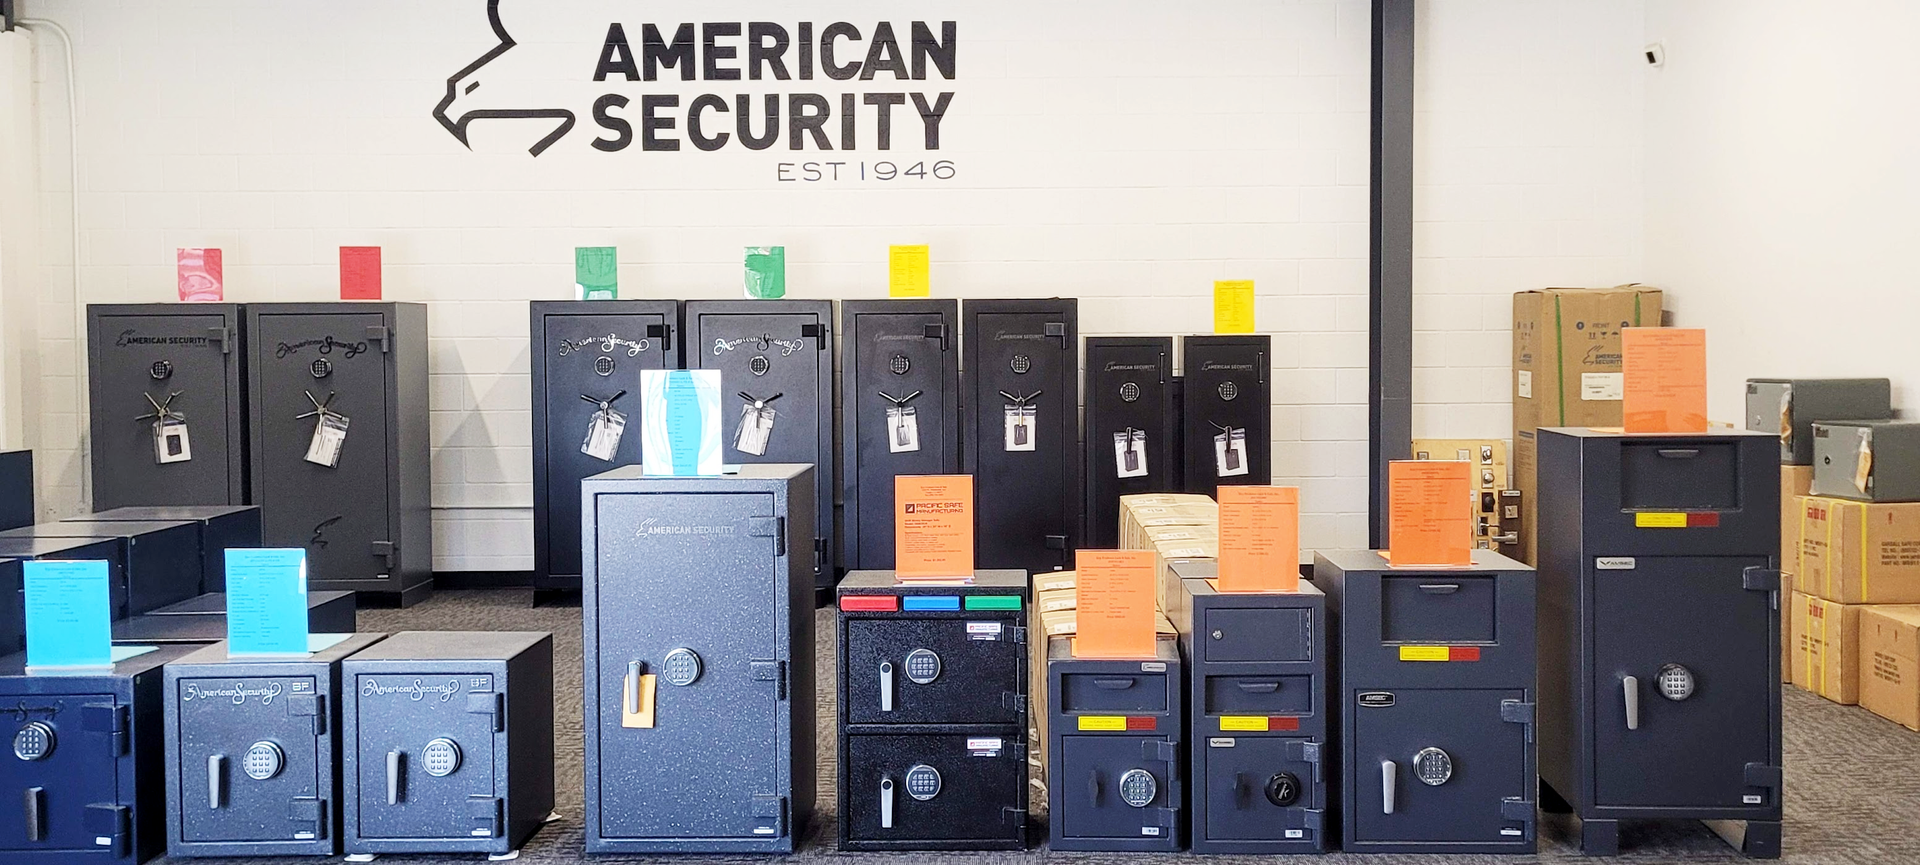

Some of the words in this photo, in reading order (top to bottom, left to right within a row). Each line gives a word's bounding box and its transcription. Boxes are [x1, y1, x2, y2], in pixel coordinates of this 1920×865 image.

[593, 21, 957, 82] AMERICAN
[590, 92, 956, 152] SECURITY
[777, 162, 846, 182] EST
[859, 160, 957, 181] 1946
[126, 337, 167, 345] AMERICAN
[168, 337, 207, 345] SECURITY
[647, 526, 692, 535] AMERICAN
[692, 525, 735, 535] SECURITY
[292, 682, 310, 692] BF
[470, 678, 489, 688] BF
